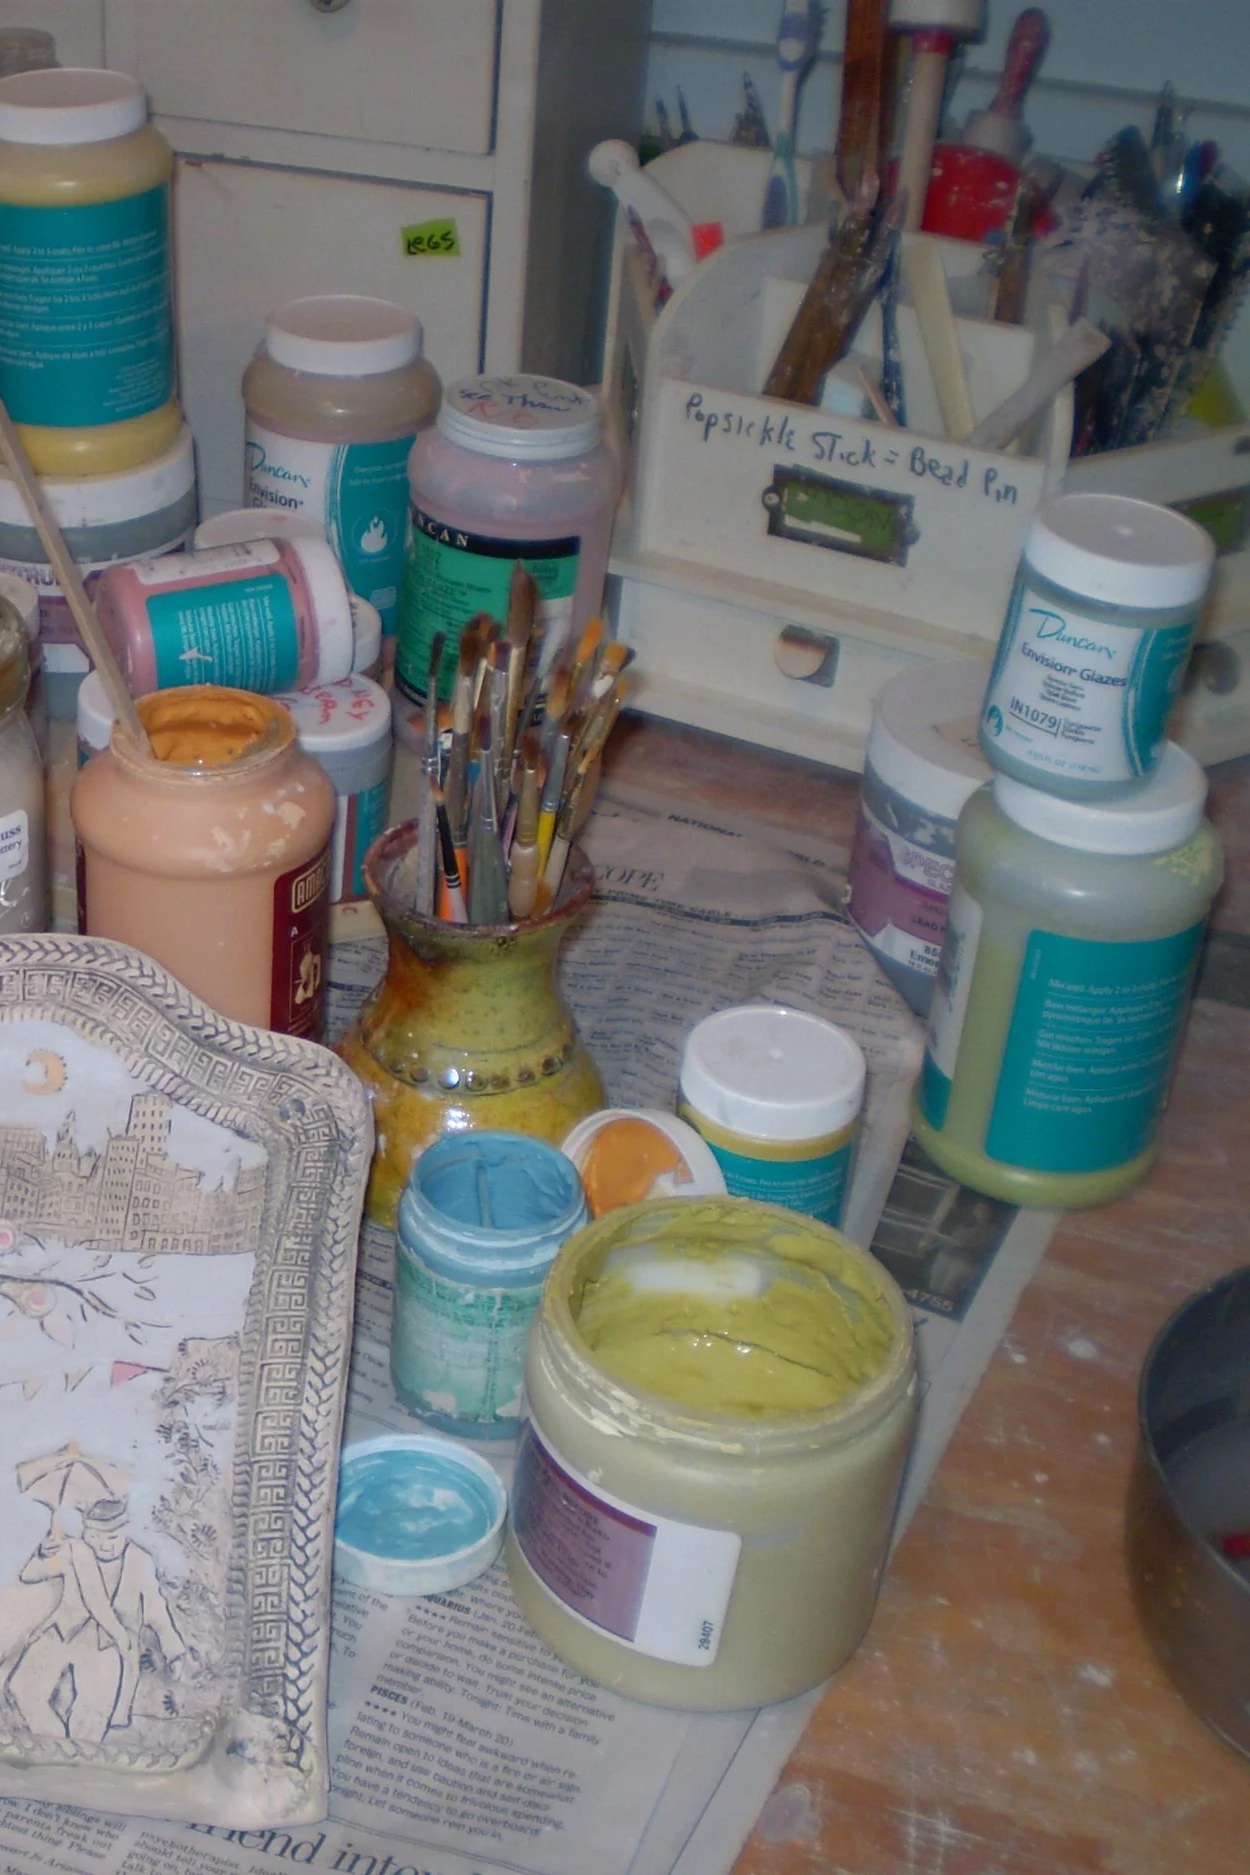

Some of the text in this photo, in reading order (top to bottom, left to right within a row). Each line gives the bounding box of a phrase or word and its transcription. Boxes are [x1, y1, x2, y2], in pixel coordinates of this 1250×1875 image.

[246, 441, 312, 489] Duncan
[909, 446, 971, 489] Bead
[1028, 607, 1118, 661] Duncan
[1079, 667, 1128, 688] Glazes
[1010, 696, 1058, 730] IN1079
[697, 1619, 716, 1650] 29407
[369, 1682, 410, 1706] PISCES
